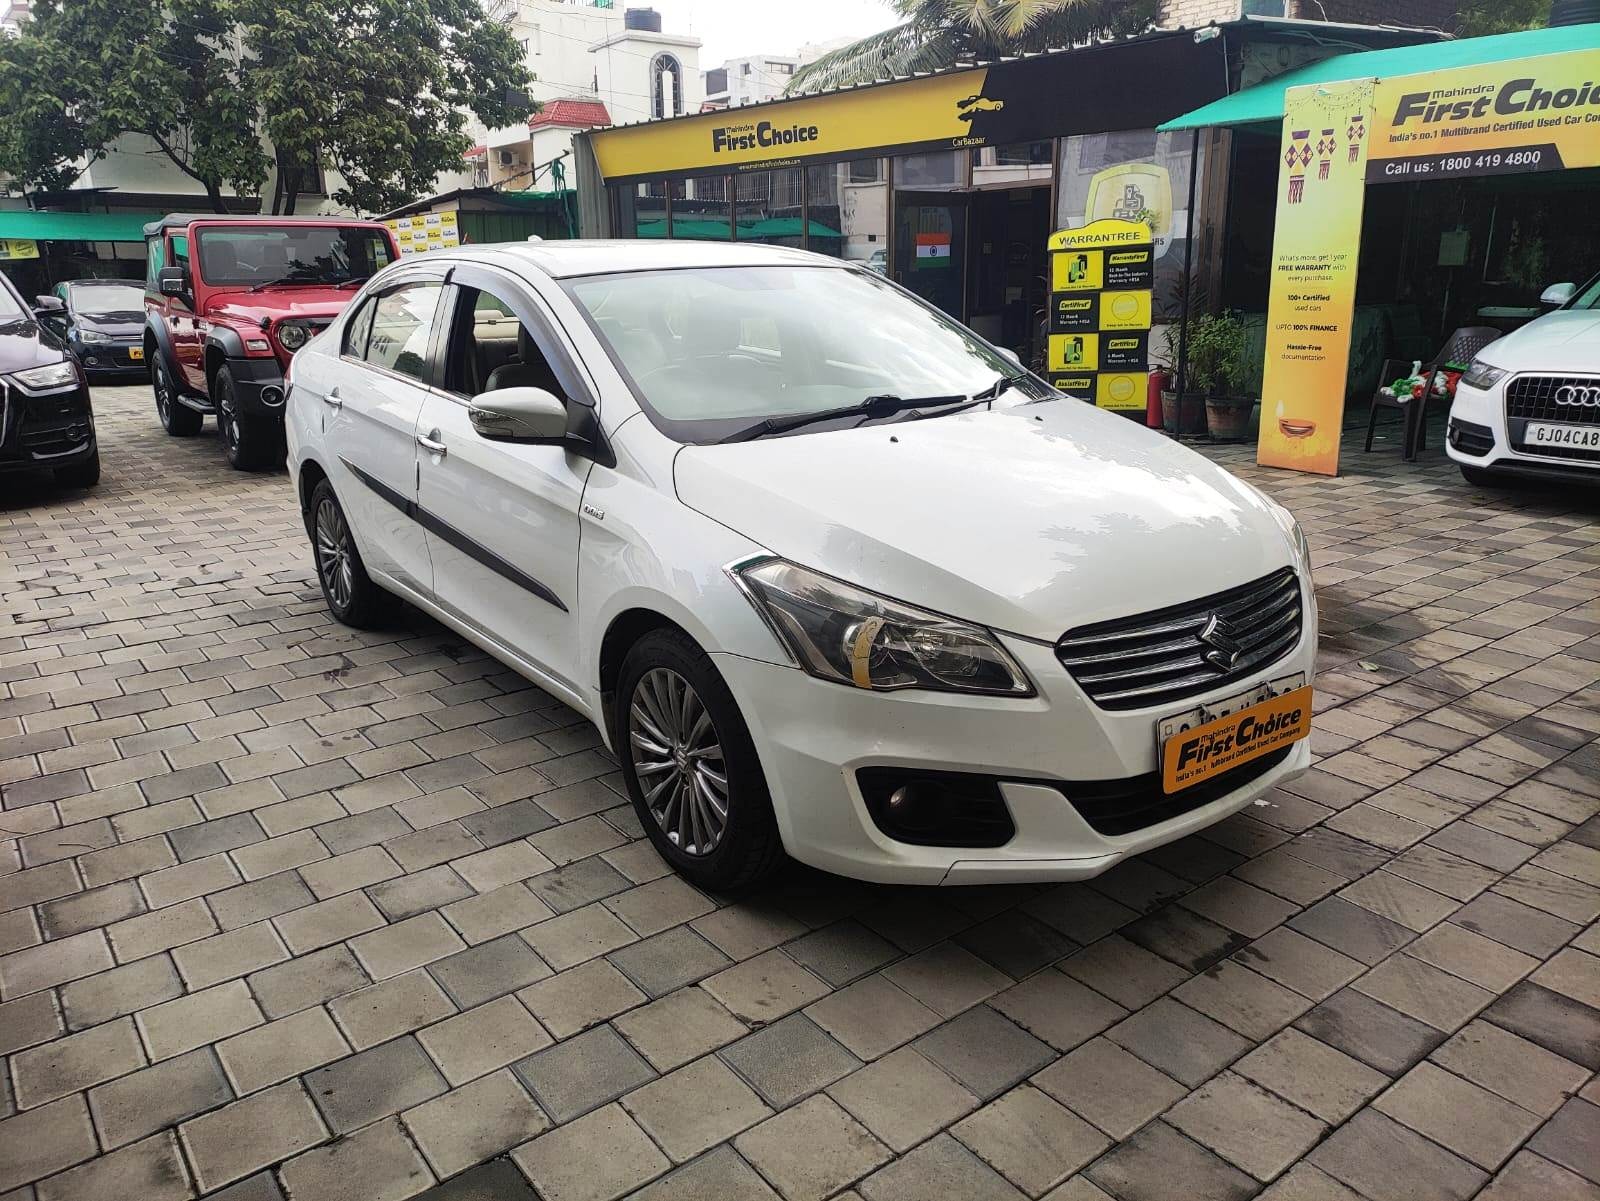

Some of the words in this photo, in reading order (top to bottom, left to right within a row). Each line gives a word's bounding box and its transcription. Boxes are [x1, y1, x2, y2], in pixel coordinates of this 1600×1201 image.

[1432, 84, 1495, 99] Mahindra
[1392, 91, 1491, 127] First
[712, 127, 756, 153] First
[756, 121, 819, 148] Choice
[1389, 132, 1417, 143] India's
[1419, 130, 1438, 139] no.1
[1440, 124, 1490, 138] Multibrand
[1493, 120, 1534, 132] Certified
[1537, 116, 1562, 127] Used
[1564, 115, 1582, 124] Car
[1584, 113, 1600, 123] Co
[952, 137, 985, 147] CarBazaar
[1385, 162, 1410, 175] Call
[1414, 161, 1435, 173] us:
[1439, 157, 1472, 171] 1800
[1475, 153, 1501, 167] 419
[1504, 150, 1541, 166] 4800
[1059, 231, 1141, 245] WARRANTREE
[1537, 427, 1600, 446] GJ04CA8
[1176, 734, 1235, 772] First
[1235, 708, 1302, 747] Choice
